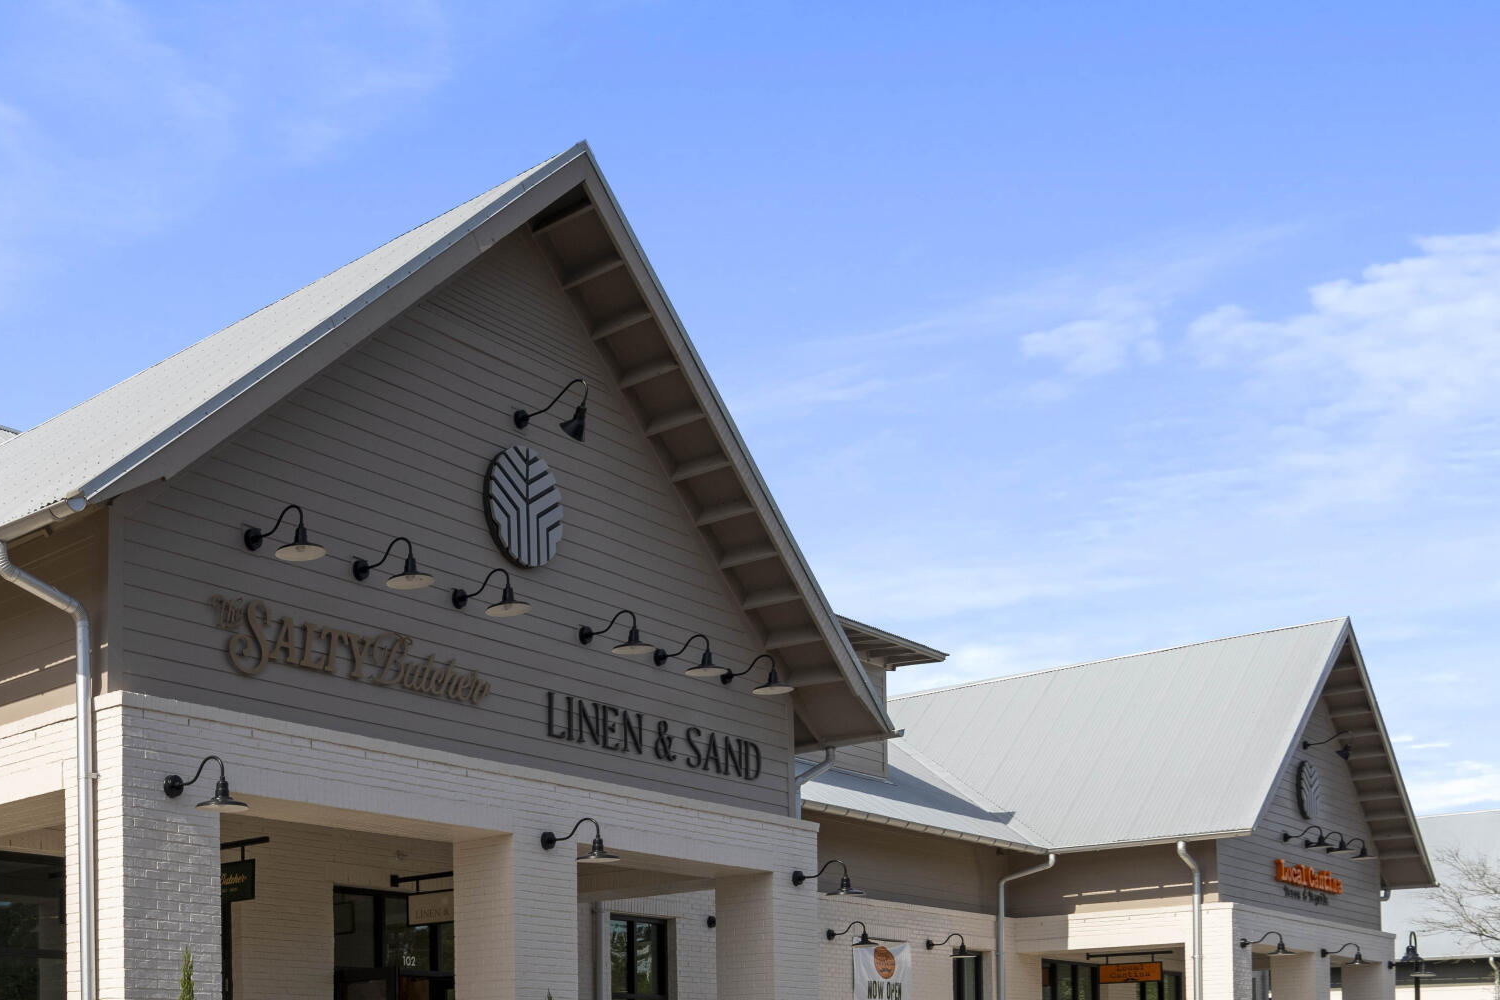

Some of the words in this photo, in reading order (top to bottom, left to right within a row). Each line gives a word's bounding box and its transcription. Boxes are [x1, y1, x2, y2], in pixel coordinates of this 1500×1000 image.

[210, 594, 245, 629] The
[228, 600, 377, 678] SALTY
[371, 631, 491, 705] Butcher
[546, 691, 644, 755] LINEN
[654, 720, 676, 762] &
[686, 726, 762, 781] SAND
[1276, 859, 1307, 886] Local
[1307, 866, 1343, 895] Cantina
[402, 955, 416, 967] 102
[867, 980, 884, 1000] NOW
[886, 982, 902, 1000] OPEN
